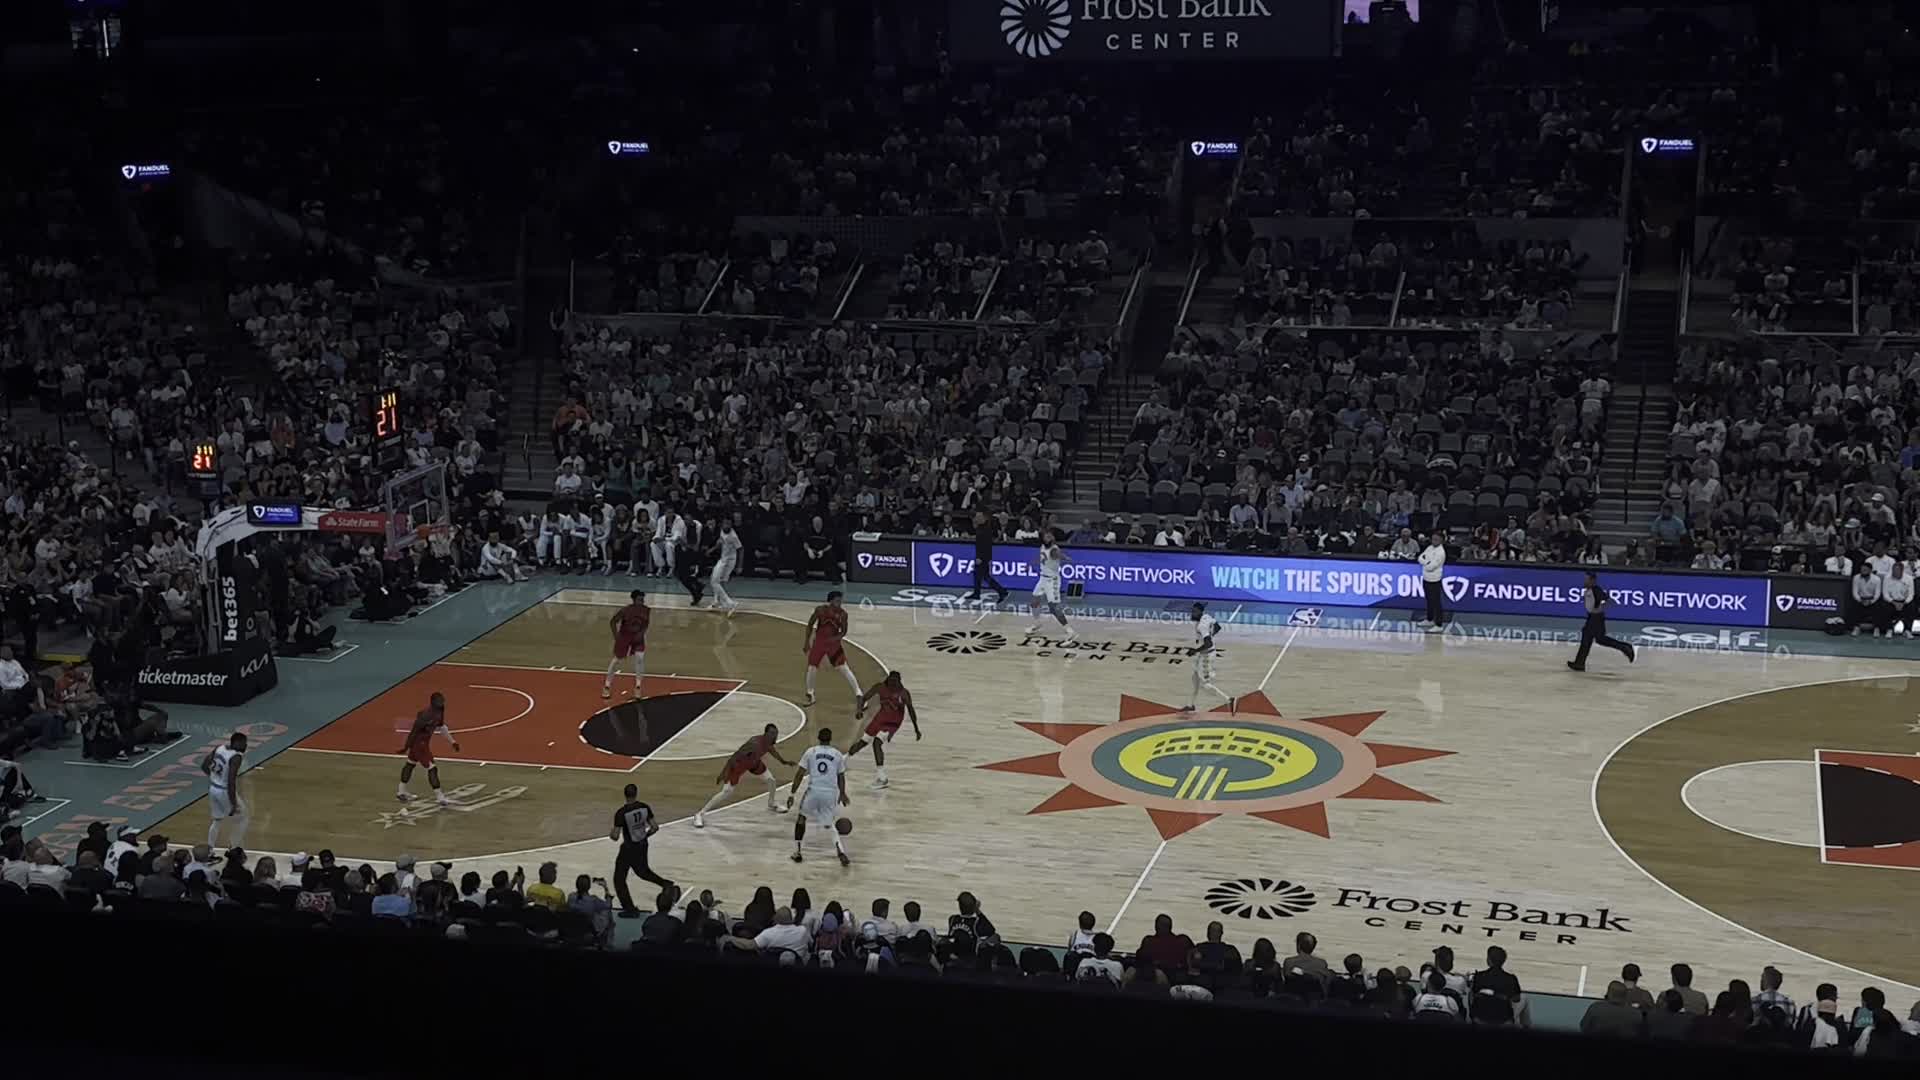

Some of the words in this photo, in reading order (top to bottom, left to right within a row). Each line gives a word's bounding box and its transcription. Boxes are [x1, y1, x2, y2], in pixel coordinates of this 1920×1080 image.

[1081, 0, 1169, 20] Frost
[1177, 0, 1272, 18] Bank
[1105, 32, 1239, 50] CENTER
[376, 407, 396, 436] 21
[193, 454, 211, 470] 21
[874, 554, 907, 563] FANDUEL
[957, 559, 1039, 577] FADUEL
[1110, 566, 1196, 585] NETWORK
[1211, 566, 1279, 590] WATCH
[1284, 569, 1322, 593] THE
[1327, 571, 1393, 596] SPURS
[1397, 575, 1425, 598] ON
[222, 575, 239, 641] bet365
[1473, 583, 1566, 602] FANDUEL
[1568, 587, 1645, 606] SRTS
[1649, 591, 1747, 611] NETWORK
[1796, 597, 1838, 606] FANDUEL
[1016, 635, 1118, 652] Frost
[138, 664, 229, 687] ticketmaster
[817, 761, 828, 773] 0
[1331, 888, 1471, 918] Frost
[1484, 901, 1632, 932] Bank
[1365, 917, 1577, 945] CENTER
